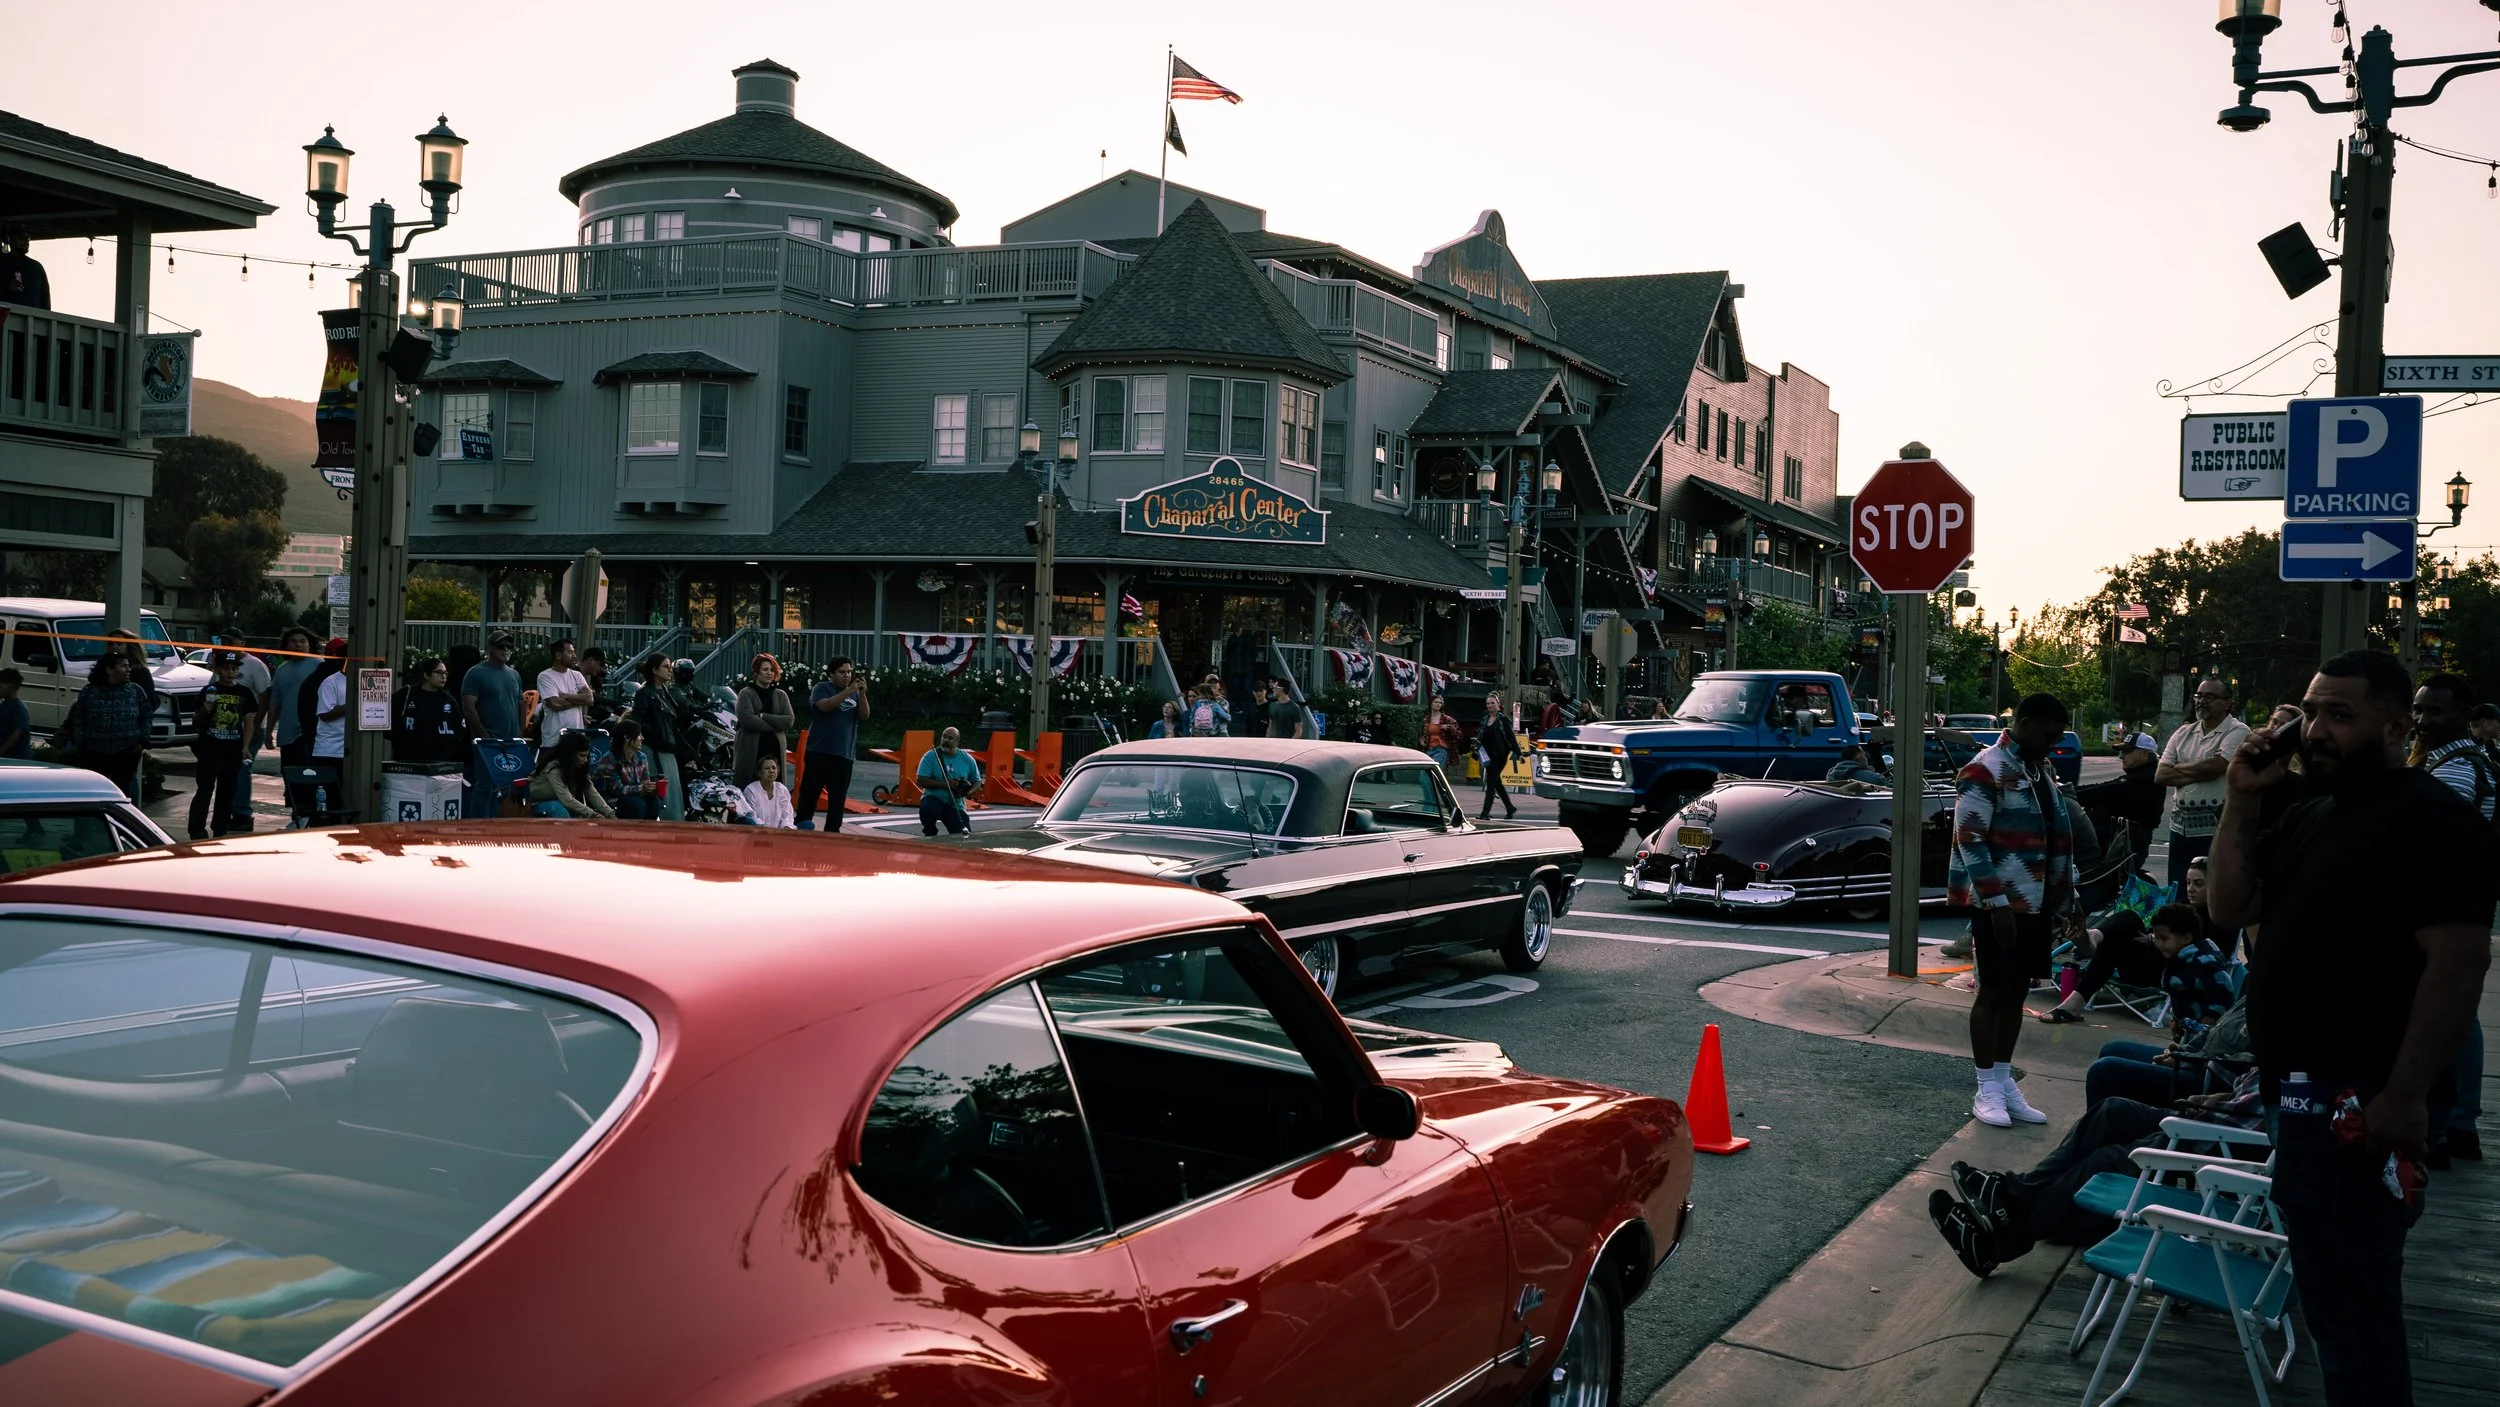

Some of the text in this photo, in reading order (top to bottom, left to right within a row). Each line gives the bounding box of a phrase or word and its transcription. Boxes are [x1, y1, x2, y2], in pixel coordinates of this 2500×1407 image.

[1448, 248, 1532, 317] Chaparral Center
[326, 326, 361, 341] ROD RU
[147, 342, 185, 362] DESTINATION
[2387, 366, 2460, 380] SIXTH
[147, 383, 183, 401] TEMECULA
[462, 432, 491, 445] EXPRESS
[2212, 421, 2275, 443] PUBLIC
[320, 441, 338, 455] Old
[471, 444, 485, 454] TAX
[2317, 405, 2389, 488] P
[2191, 448, 2286, 471] RESTROOM
[1209, 476, 1245, 486] 28465
[1143, 487, 1307, 534] Chaparral Center
[2294, 492, 2410, 513] PARKING
[1859, 502, 1965, 551] STOP
[362, 691, 388, 703] PARKING
[2280, 1096, 2311, 1111] MEX
